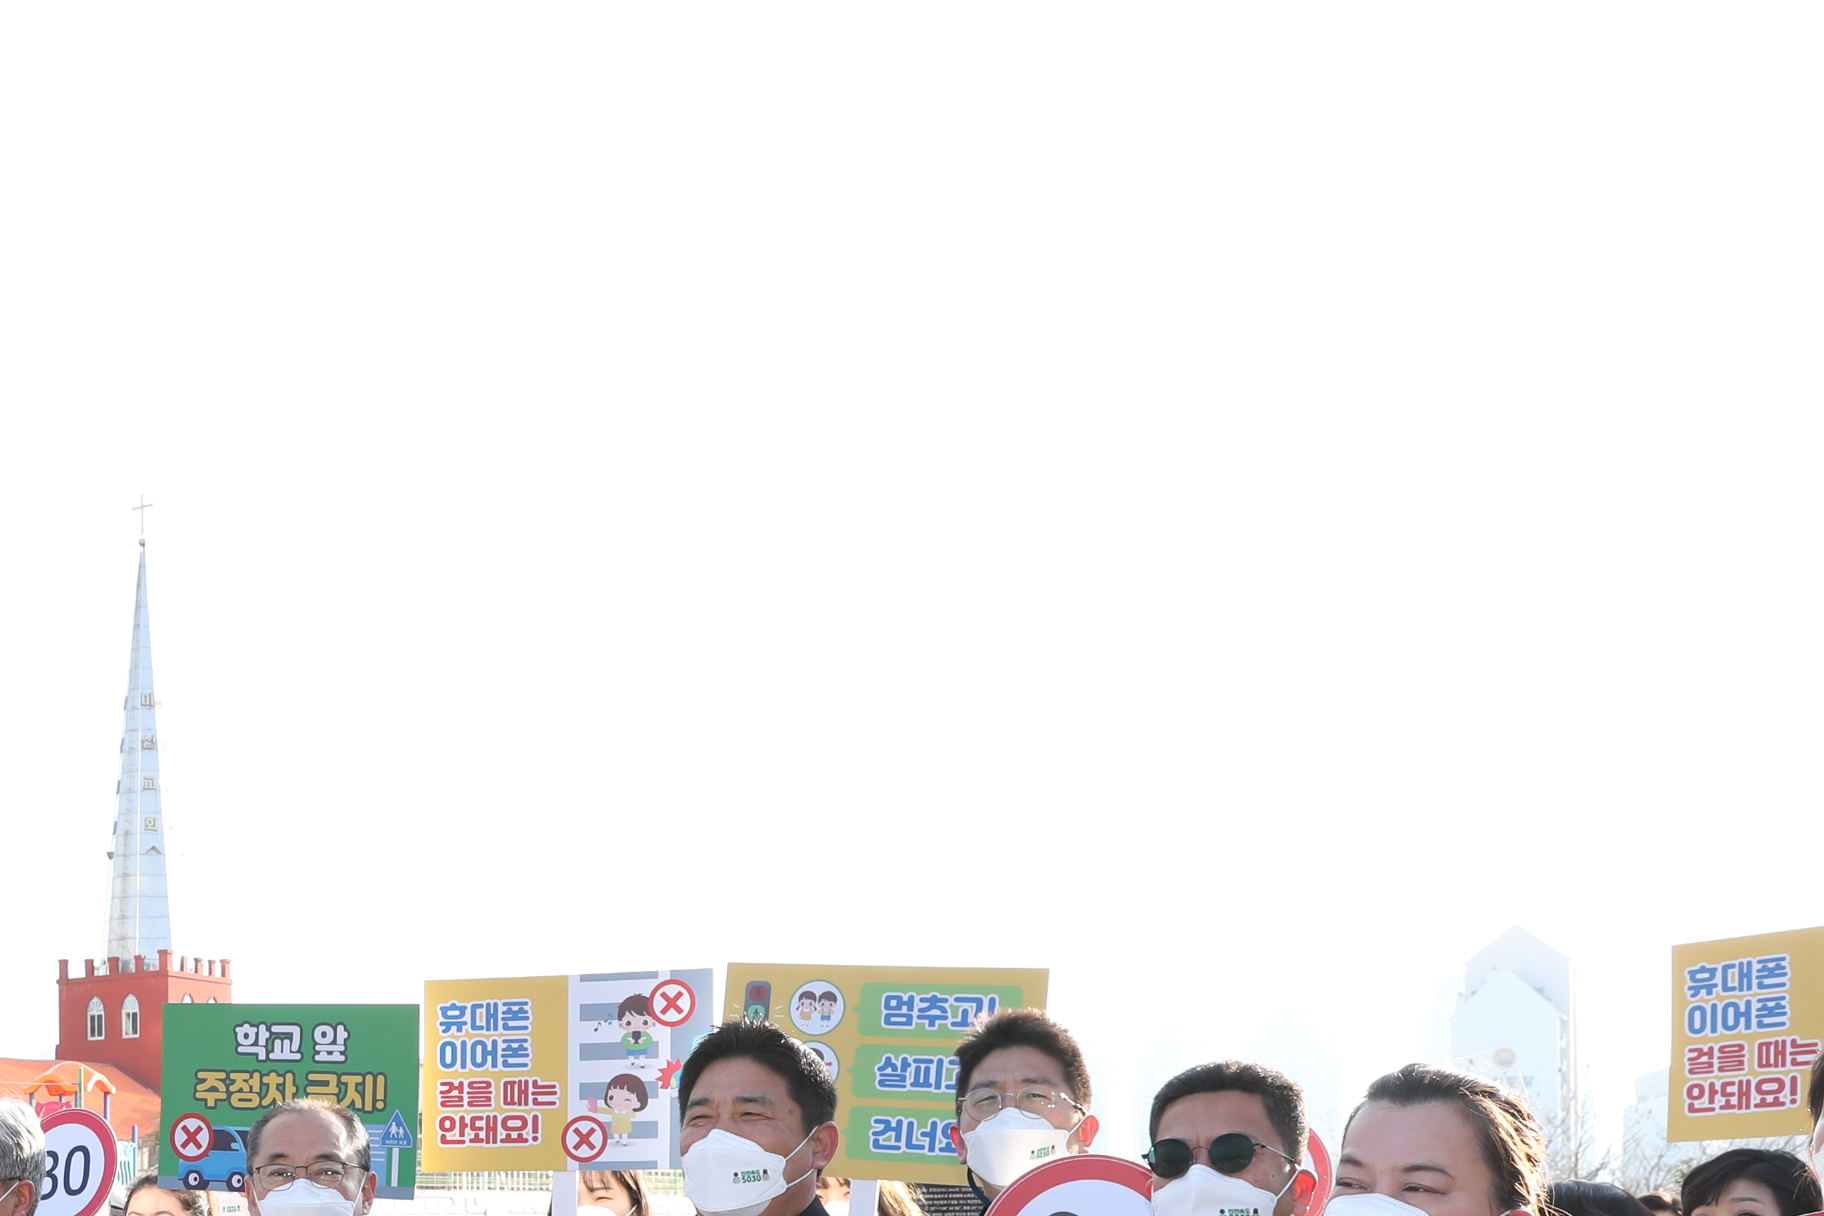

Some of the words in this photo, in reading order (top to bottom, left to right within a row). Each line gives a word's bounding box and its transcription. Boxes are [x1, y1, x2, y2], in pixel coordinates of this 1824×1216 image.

[1685, 954, 1791, 998] 휴대폰
[438, 1000, 531, 1035] 휴대폰
[1686, 994, 1789, 1036] 이어폰
[234, 1022, 303, 1062] 학교
[313, 1023, 350, 1063] 앞
[438, 1037, 531, 1071] 이어폰
[1686, 1043, 1748, 1076] 걸을
[1755, 1037, 1820, 1070] 때는
[195, 1070, 297, 1109] 주정차
[876, 1055, 961, 1091] 살피
[438, 1079, 494, 1109] 걸을
[501, 1078, 559, 1108] 때는
[1684, 1073, 1801, 1116] 안돼요!
[437, 1113, 540, 1146] 안돼요!
[871, 1117, 958, 1154] 건너
[41, 1145, 91, 1200] 30
[741, 1175, 762, 1183] 5030
